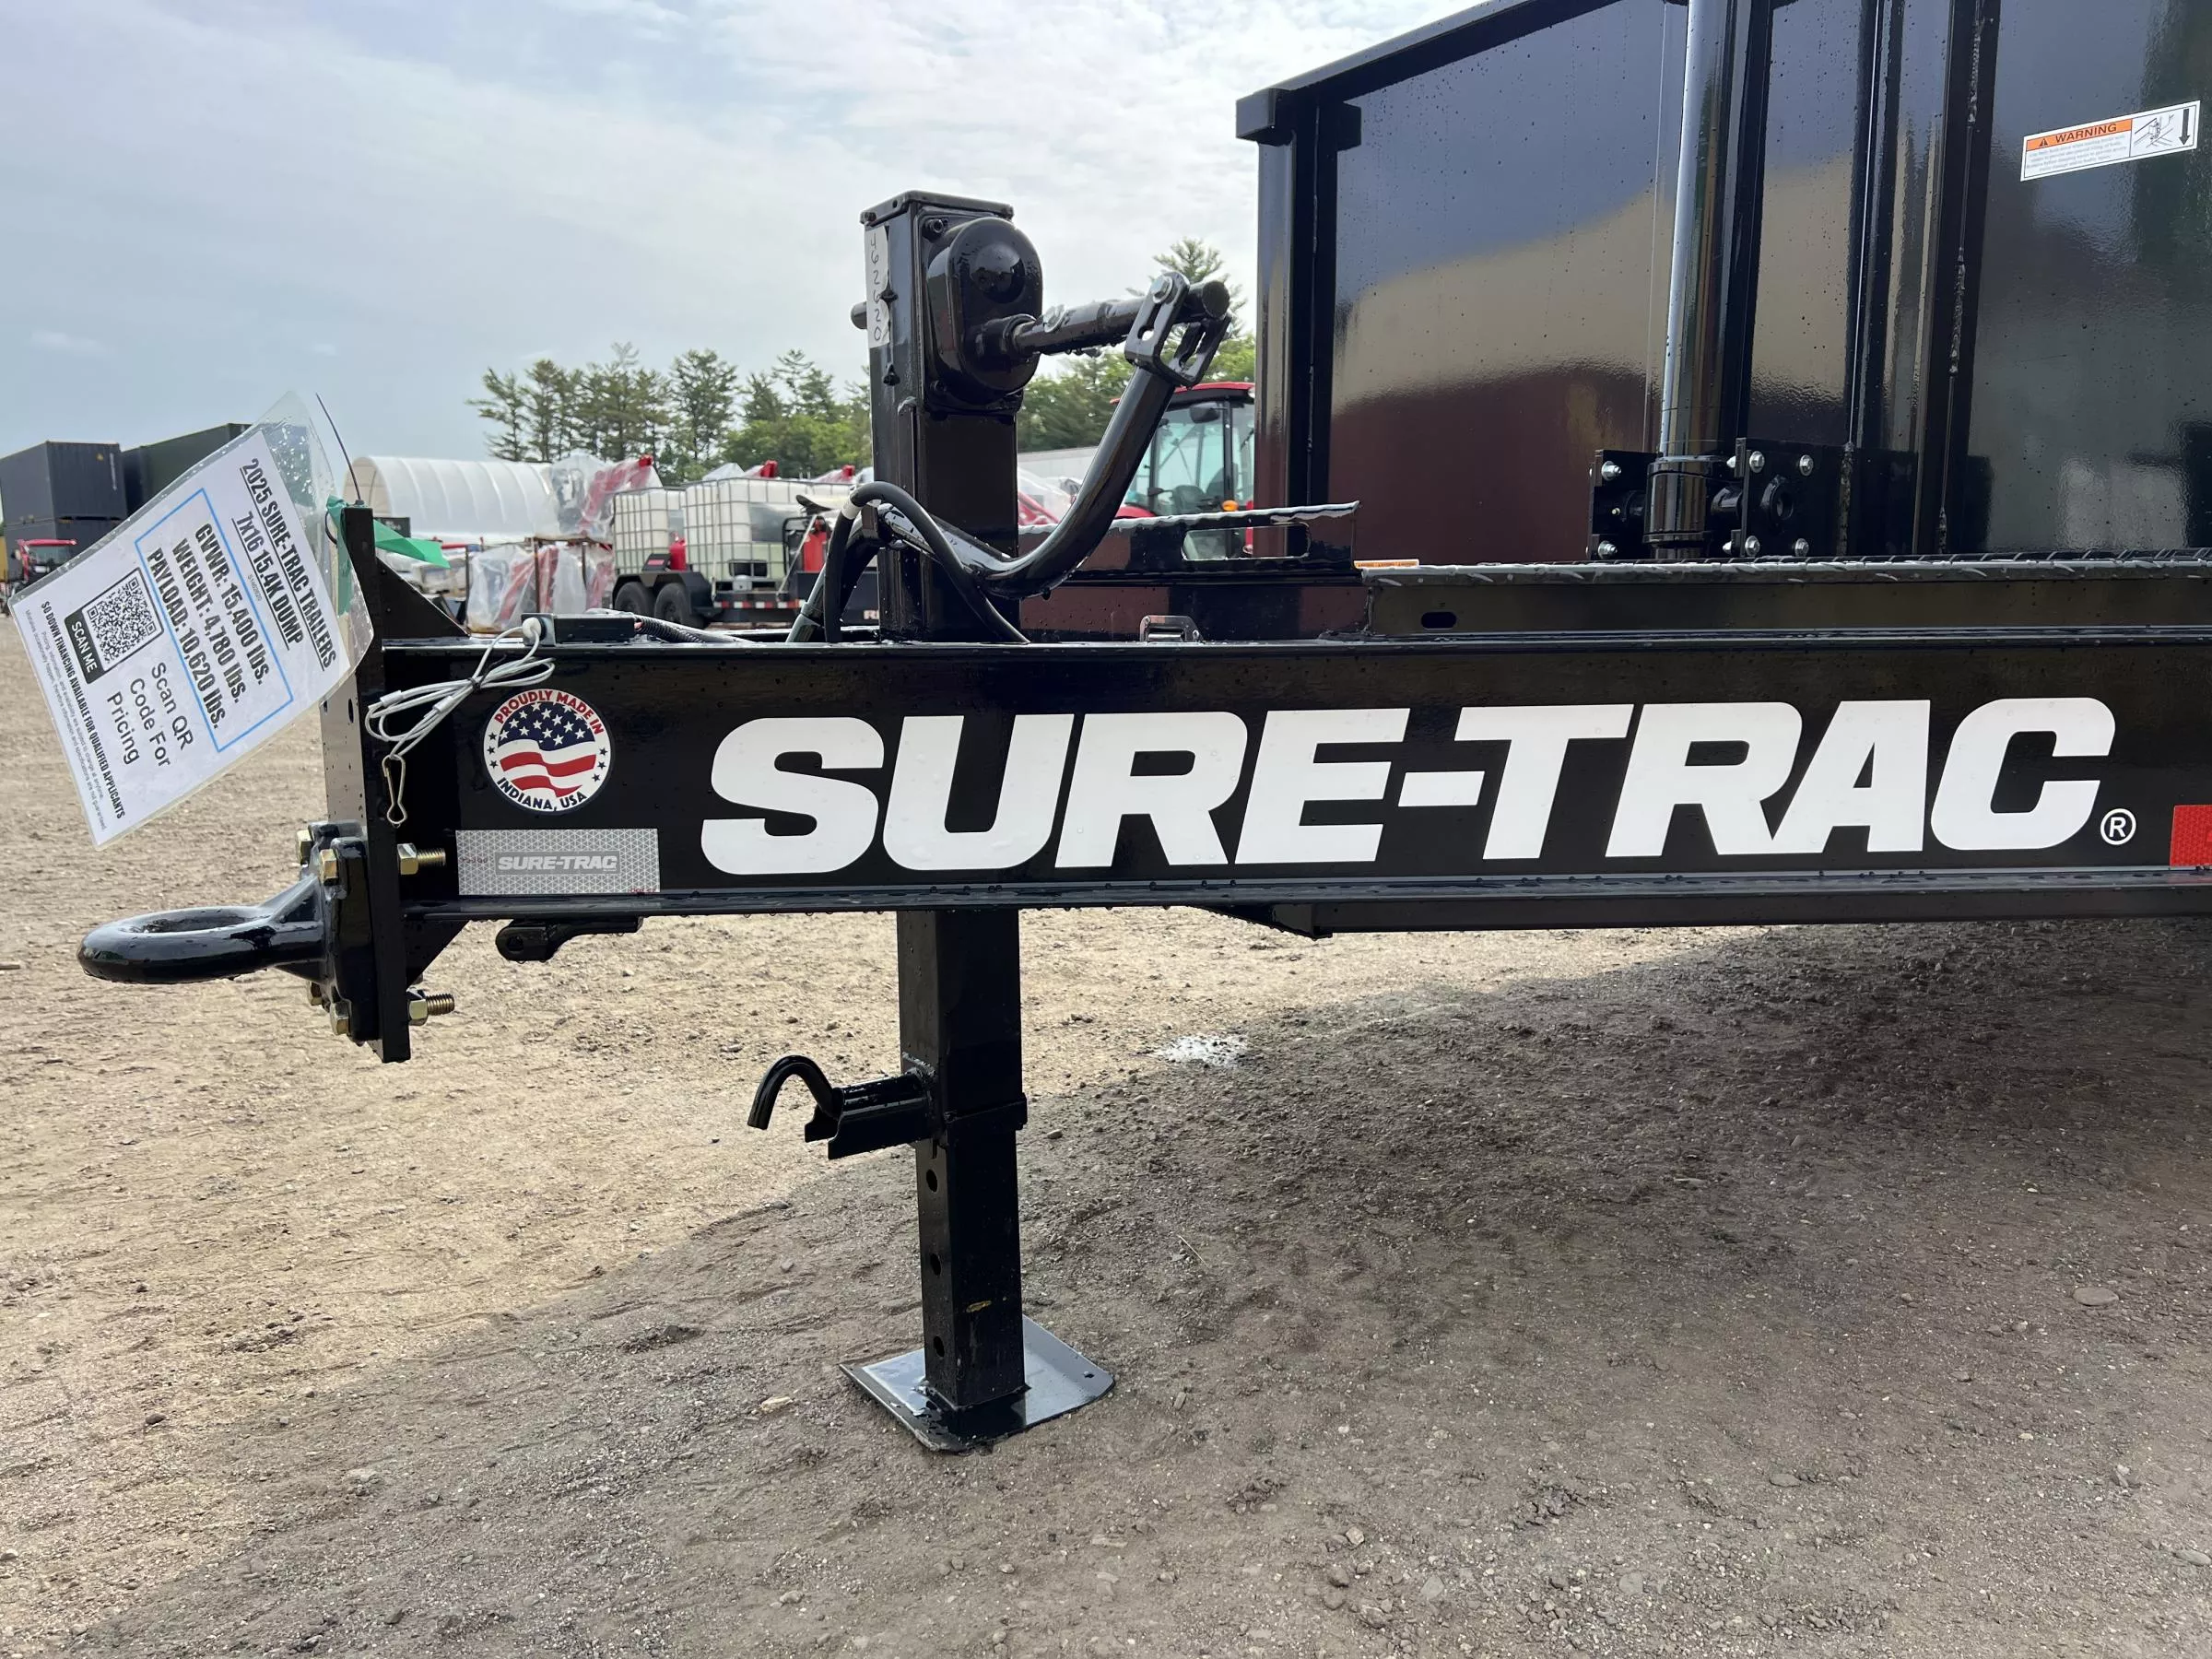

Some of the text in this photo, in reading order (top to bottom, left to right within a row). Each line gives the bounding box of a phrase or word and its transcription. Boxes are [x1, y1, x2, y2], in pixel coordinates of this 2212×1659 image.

[2055, 123, 2117, 144] WARNING
[237, 511, 303, 643] 7x16 15.4K DUMP
[242, 458, 336, 667] 2025 SURE-TRAC TRAILERS
[46, 612, 61, 638] DOWN
[172, 538, 246, 703] WEIGHT: 4,780 lbs.
[195, 524, 269, 685] GVWR: 15,400 lbs.
[54, 636, 76, 678] FINANCING
[72, 621, 97, 673] SCAN ME
[147, 547, 225, 729] PAYLOAD: 10,620 lbs.
[69, 677, 89, 717] AVAILABLE
[151, 662, 194, 750] Scan QR
[494, 689, 606, 735] PROUDLY MADE IN
[84, 716, 95, 733] FOR
[107, 691, 140, 765] Pricing
[130, 678, 171, 766] Code For
[89, 732, 109, 771] QUALIFIED
[103, 771, 125, 818] APPLICANTS
[496, 776, 588, 812] INDIANA, USA
[701, 698, 2115, 874] SURE-TRAC
[498, 854, 618, 871] SURE-TRAC
